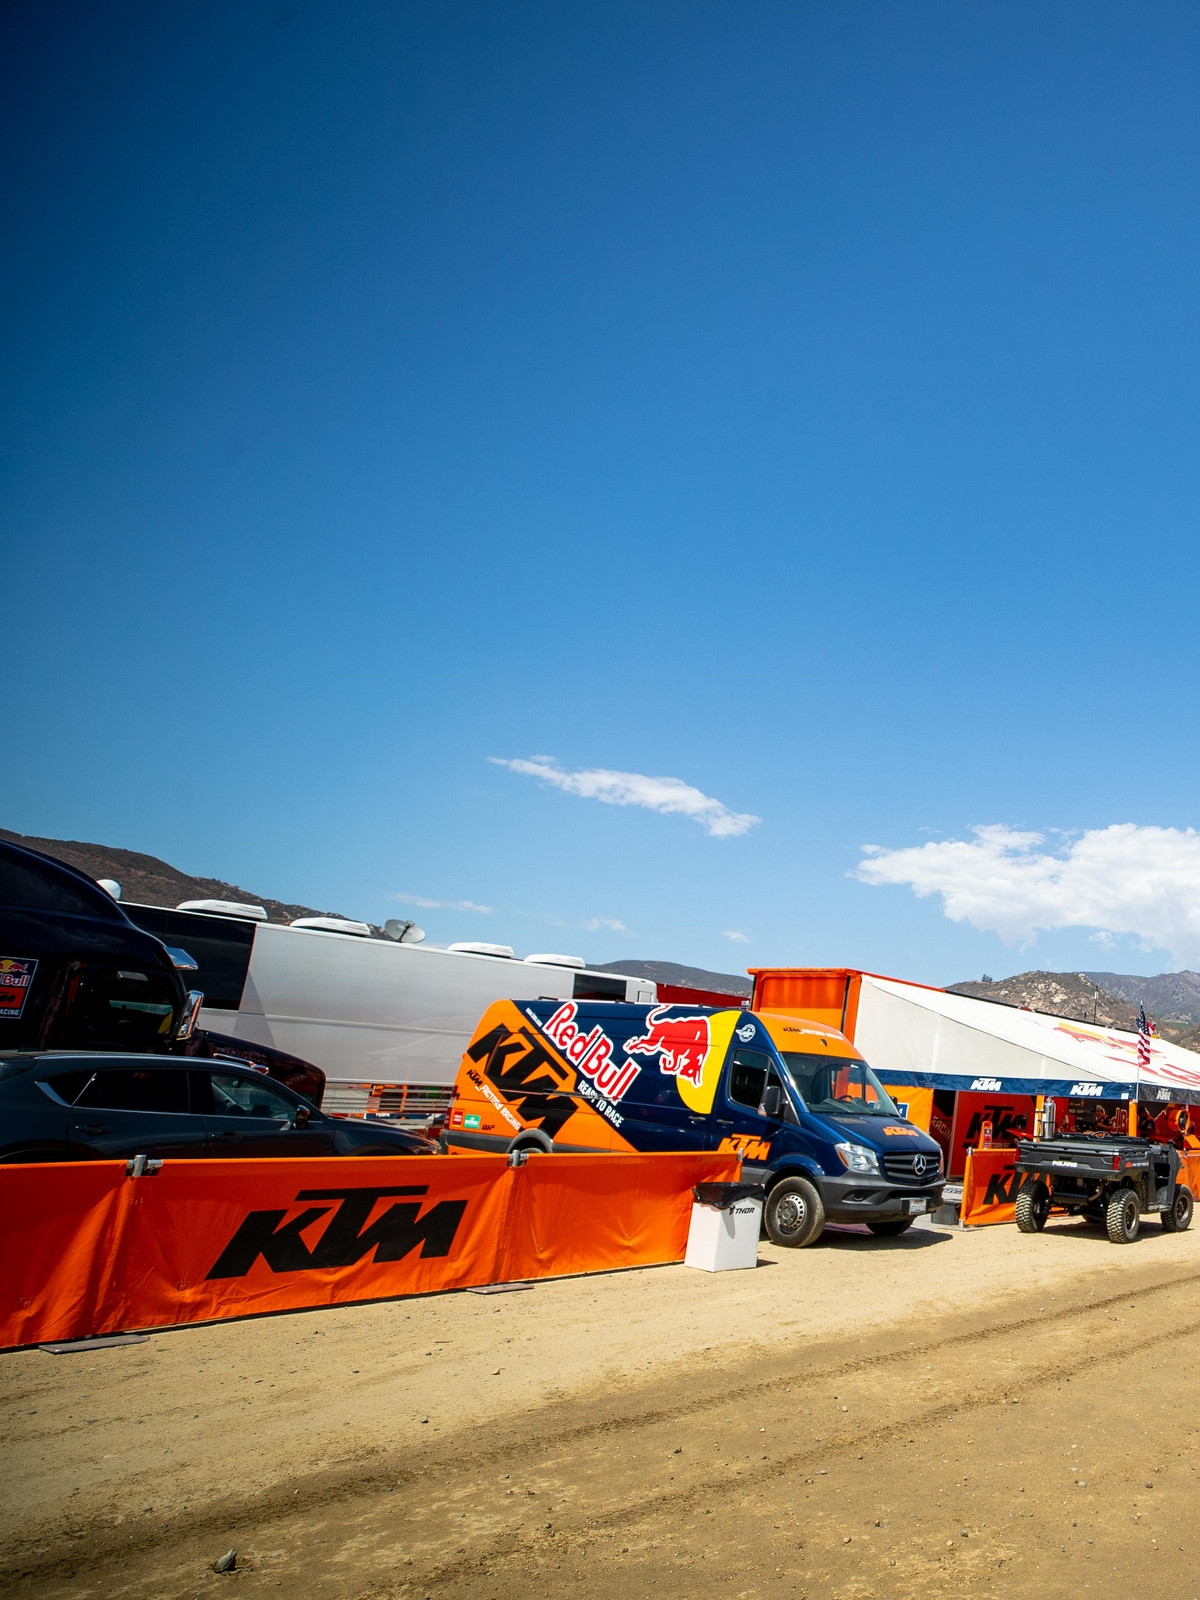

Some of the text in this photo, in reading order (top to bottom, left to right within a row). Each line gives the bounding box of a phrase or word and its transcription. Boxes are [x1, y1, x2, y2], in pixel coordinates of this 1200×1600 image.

[2, 973, 31, 987] Bull
[0, 1008, 20, 1016] ACING
[542, 1001, 642, 1105] Red Bull
[466, 1023, 579, 1139] KTM
[970, 1078, 1002, 1092] KTM
[1070, 1082, 1104, 1097] KTM
[466, 1069, 483, 1087] KTM
[500, 1107, 521, 1131] RACING
[1156, 1087, 1171, 1101] KTM
[603, 1105, 625, 1128] RACE
[882, 1125, 919, 1136] KTM
[931, 1115, 952, 1140] RACIN
[717, 1133, 771, 1161] KTM
[1052, 1160, 1078, 1168] POLARIS
[204, 1184, 469, 1281] KTM
